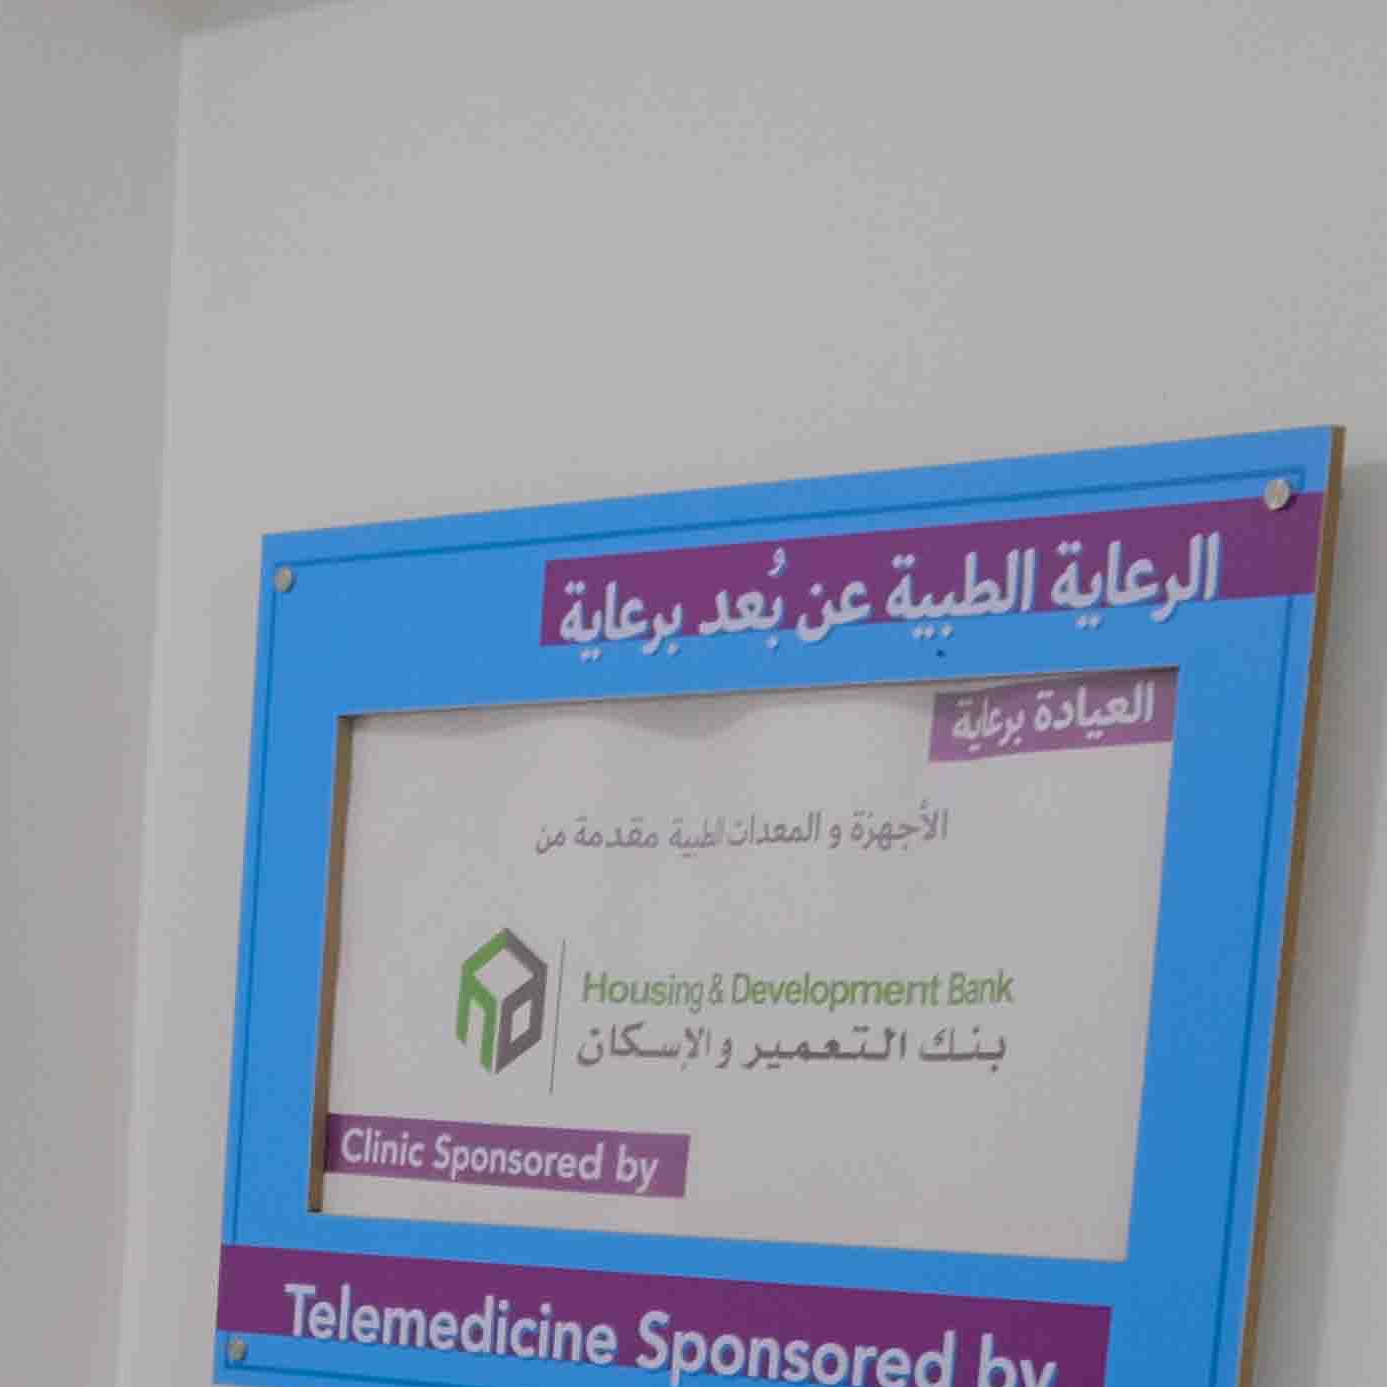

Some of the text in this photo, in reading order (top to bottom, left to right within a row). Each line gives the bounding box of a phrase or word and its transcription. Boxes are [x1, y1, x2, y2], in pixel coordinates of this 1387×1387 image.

[795, 577, 872, 644] عن
[886, 547, 1035, 640] الطبية
[1051, 531, 1219, 628] الرعاية
[559, 580, 682, 661] برعاية
[952, 681, 1154, 751] العيادة برعاية
[535, 824, 565, 854] من
[573, 815, 659, 848] مقدمة
[731, 971, 941, 1011] Development
[949, 969, 1014, 1002] Bank
[742, 1024, 907, 1070] التعمير
[919, 1024, 1007, 1073] بنك
[341, 1127, 660, 1194] Clinic Sponsored by
[285, 1283, 618, 1367] Telemedicine
